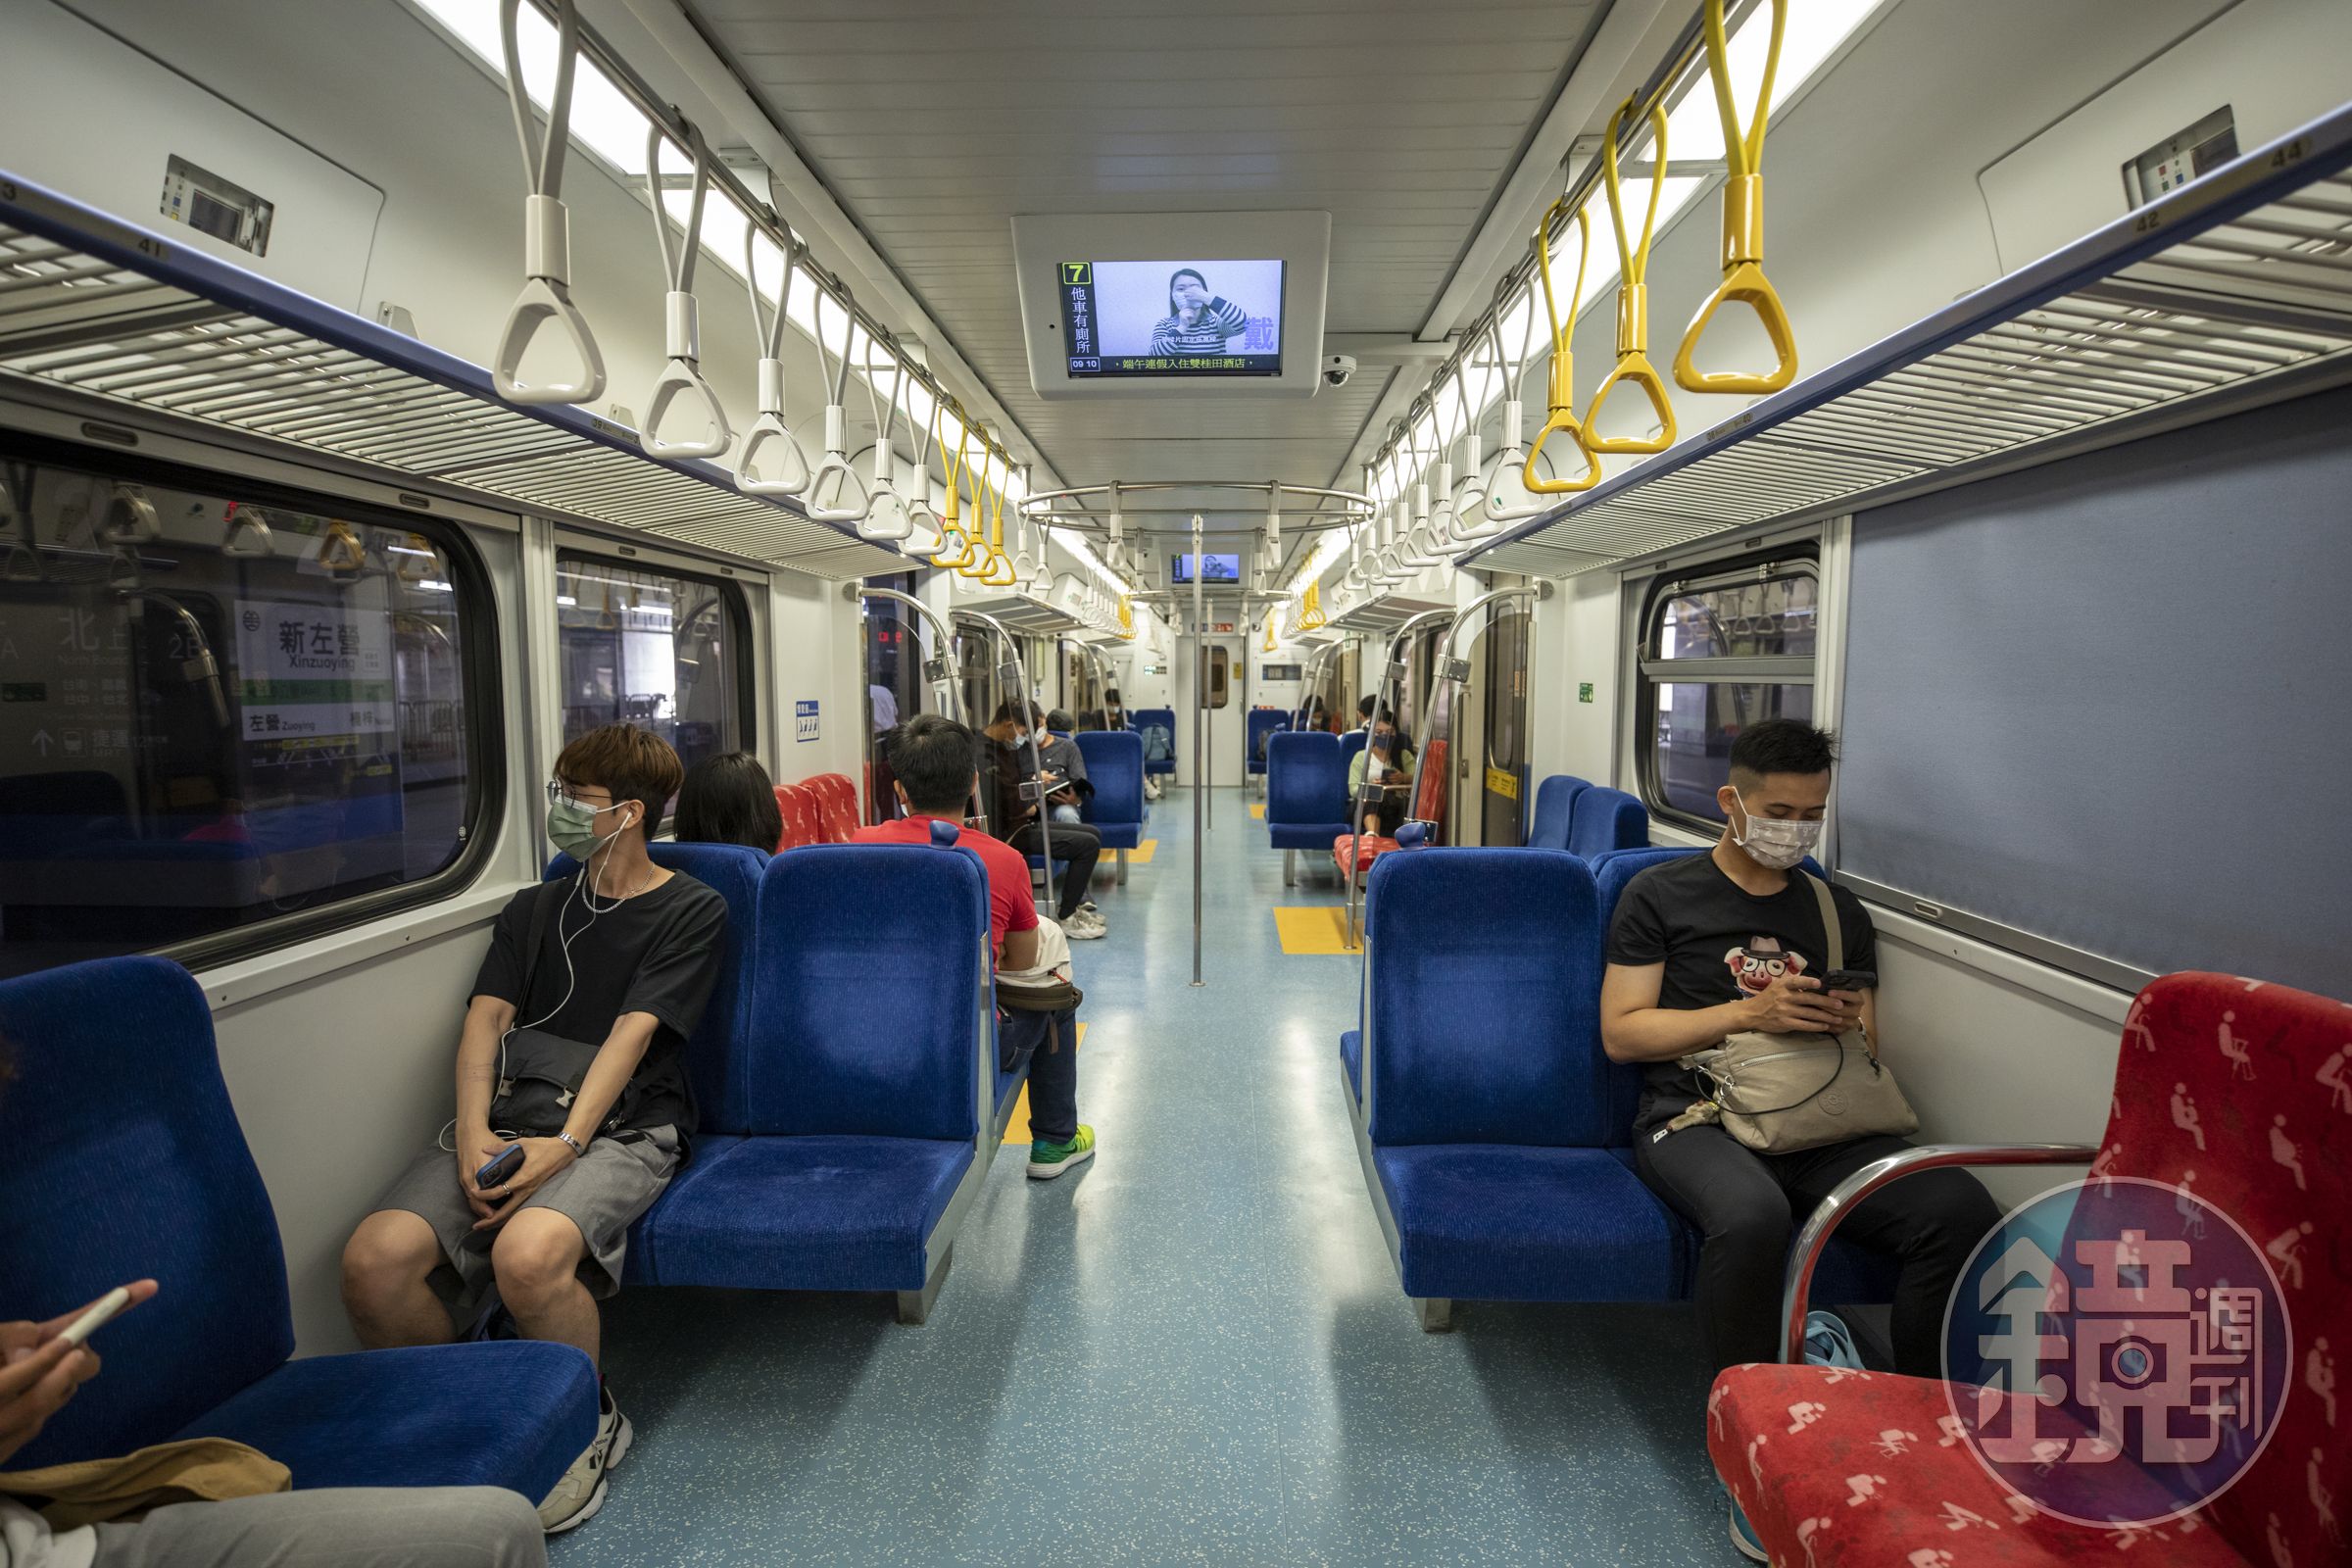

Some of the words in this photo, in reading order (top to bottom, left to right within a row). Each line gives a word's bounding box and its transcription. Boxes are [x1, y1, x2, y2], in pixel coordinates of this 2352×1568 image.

[2136, 211, 2161, 232] 42
[139, 237, 161, 257] 41
[1068, 265, 1084, 282] 7
[1071, 287, 1091, 354] 他車有廁所
[1244, 318, 1274, 352] 戴
[279, 620, 360, 656] 新左營
[289, 654, 355, 672] Xinzuoying
[250, 713, 280, 732] 左營
[282, 720, 317, 733] Zuoying
